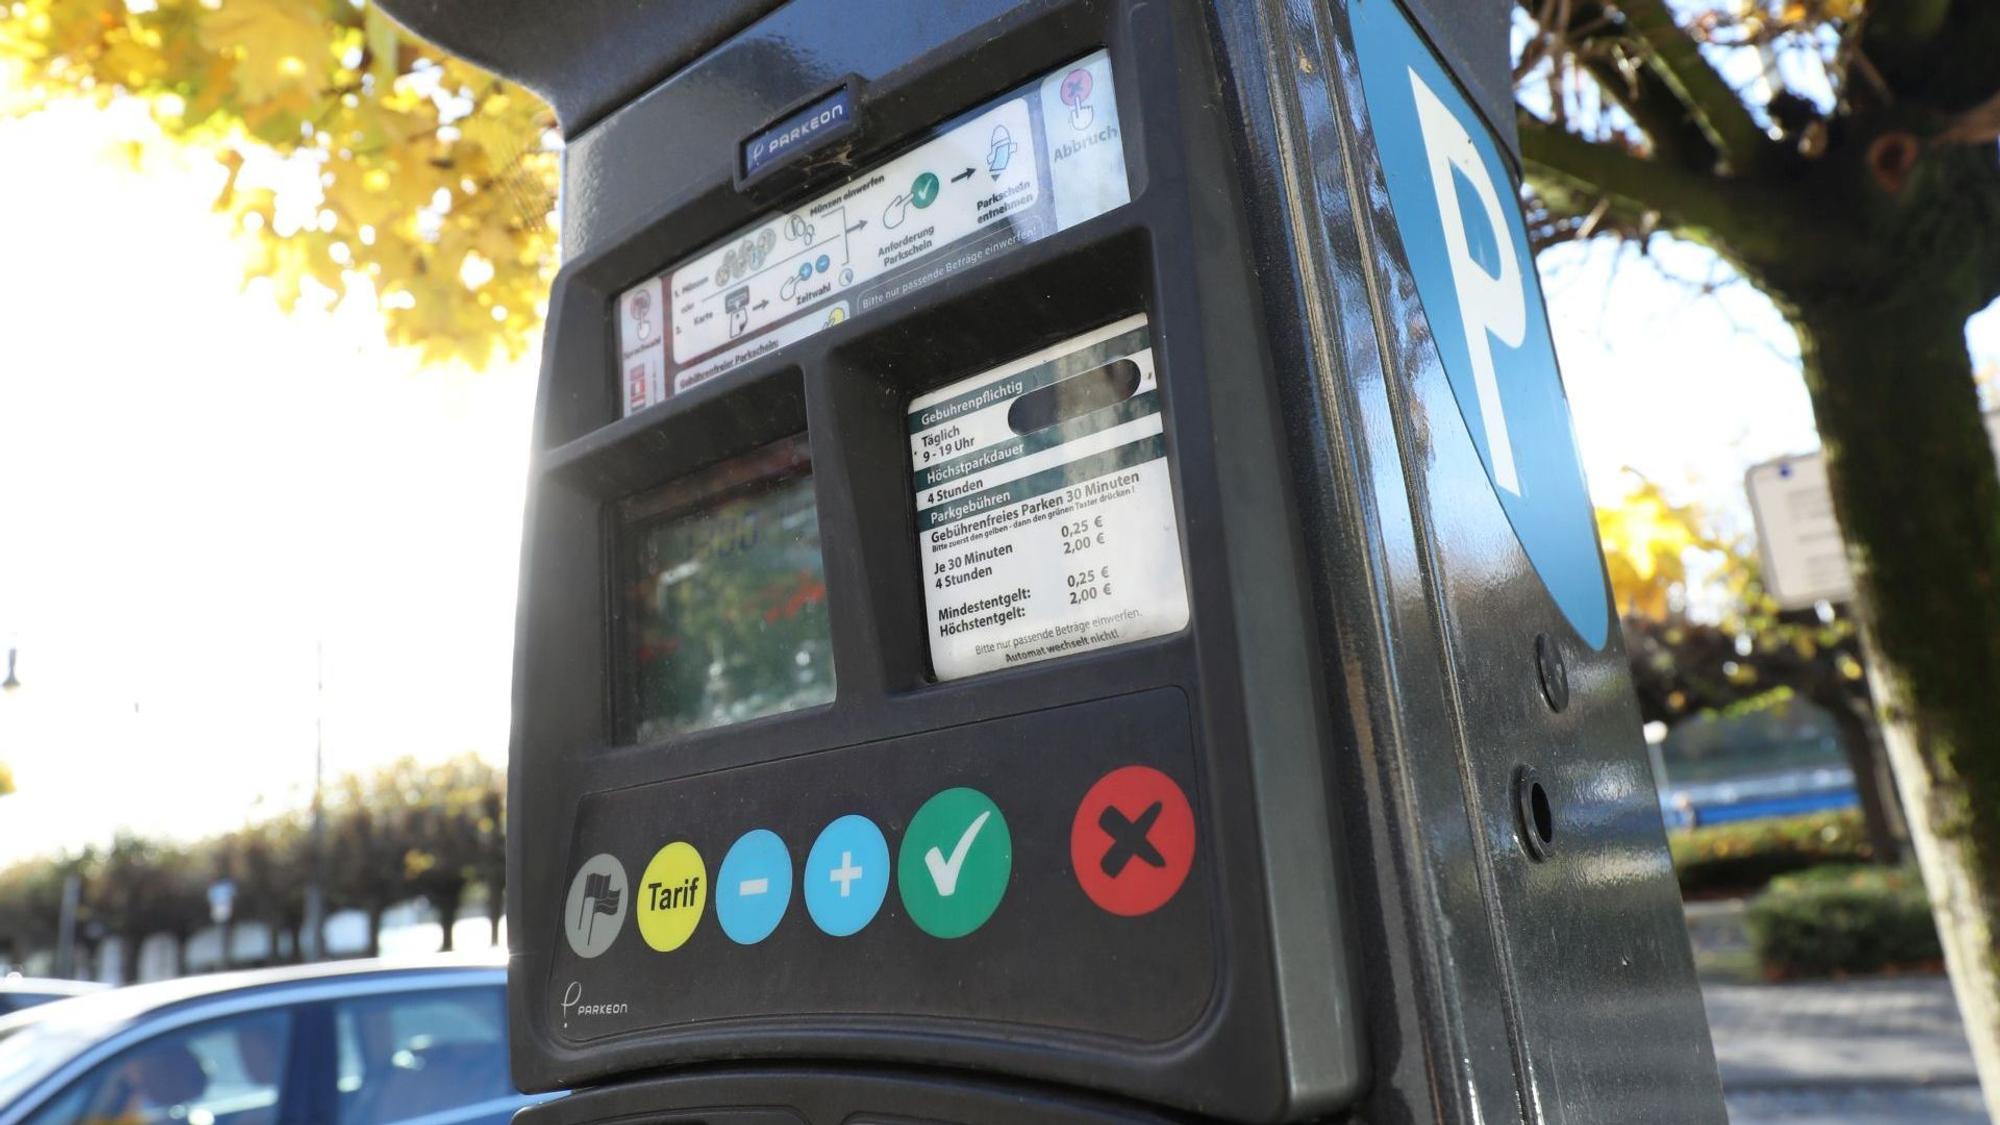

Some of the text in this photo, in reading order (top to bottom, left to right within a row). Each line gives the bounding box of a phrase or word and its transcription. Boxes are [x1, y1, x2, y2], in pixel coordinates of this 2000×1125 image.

[769, 104, 844, 153] PARKEON
[1054, 125, 1118, 163] Abbruch
[843, 175, 885, 201] einwerfen
[976, 180, 1031, 211] Parkschein
[976, 193, 1034, 224] entnehmen
[878, 226, 934, 257] Anforderung
[883, 240, 933, 267] Parkschein
[796, 283, 831, 306] Zeitwahl
[862, 293, 883, 309] Bitte
[885, 287, 900, 299] nur
[902, 266, 945, 293] passende
[1407, 64, 1526, 497] P
[921, 425, 961, 448] Täglich
[922, 450, 931, 463] 9
[939, 445, 953, 458] 19
[953, 435, 975, 452] Uhr
[927, 443, 1024, 485] Höchstparkdauer
[927, 479, 984, 504] 4 Stunden
[930, 491, 1011, 525] Parkgebühren
[931, 471, 1140, 544] Gebührenfreies Parken 30 Minuten
[931, 542, 948, 553] Bitte
[948, 536, 969, 548] zuerst
[970, 532, 984, 542] den
[984, 524, 1009, 539] gelben
[1013, 518, 1032, 529] dann
[1032, 512, 1047, 522] den
[1047, 503, 1074, 520] grünen
[1074, 497, 1099, 511] Taster
[933, 515, 1104, 576] Je 30 Minuten 0,25 €
[935, 531, 1106, 589] 4 Stunden 2,00 €
[938, 565, 1110, 622] Mindestentgelt: 0,25 €
[940, 582, 1112, 638] Höchstentgelt: 2,00 €
[975, 643, 996, 656] Bitte
[996, 638, 1011, 650] nur
[1013, 630, 1054, 648] passende
[1005, 645, 1050, 664] Automat
[1046, 636, 1089, 654] wechselt
[648, 876, 699, 911] Tarif
[577, 1003, 628, 1016] PARKEON
